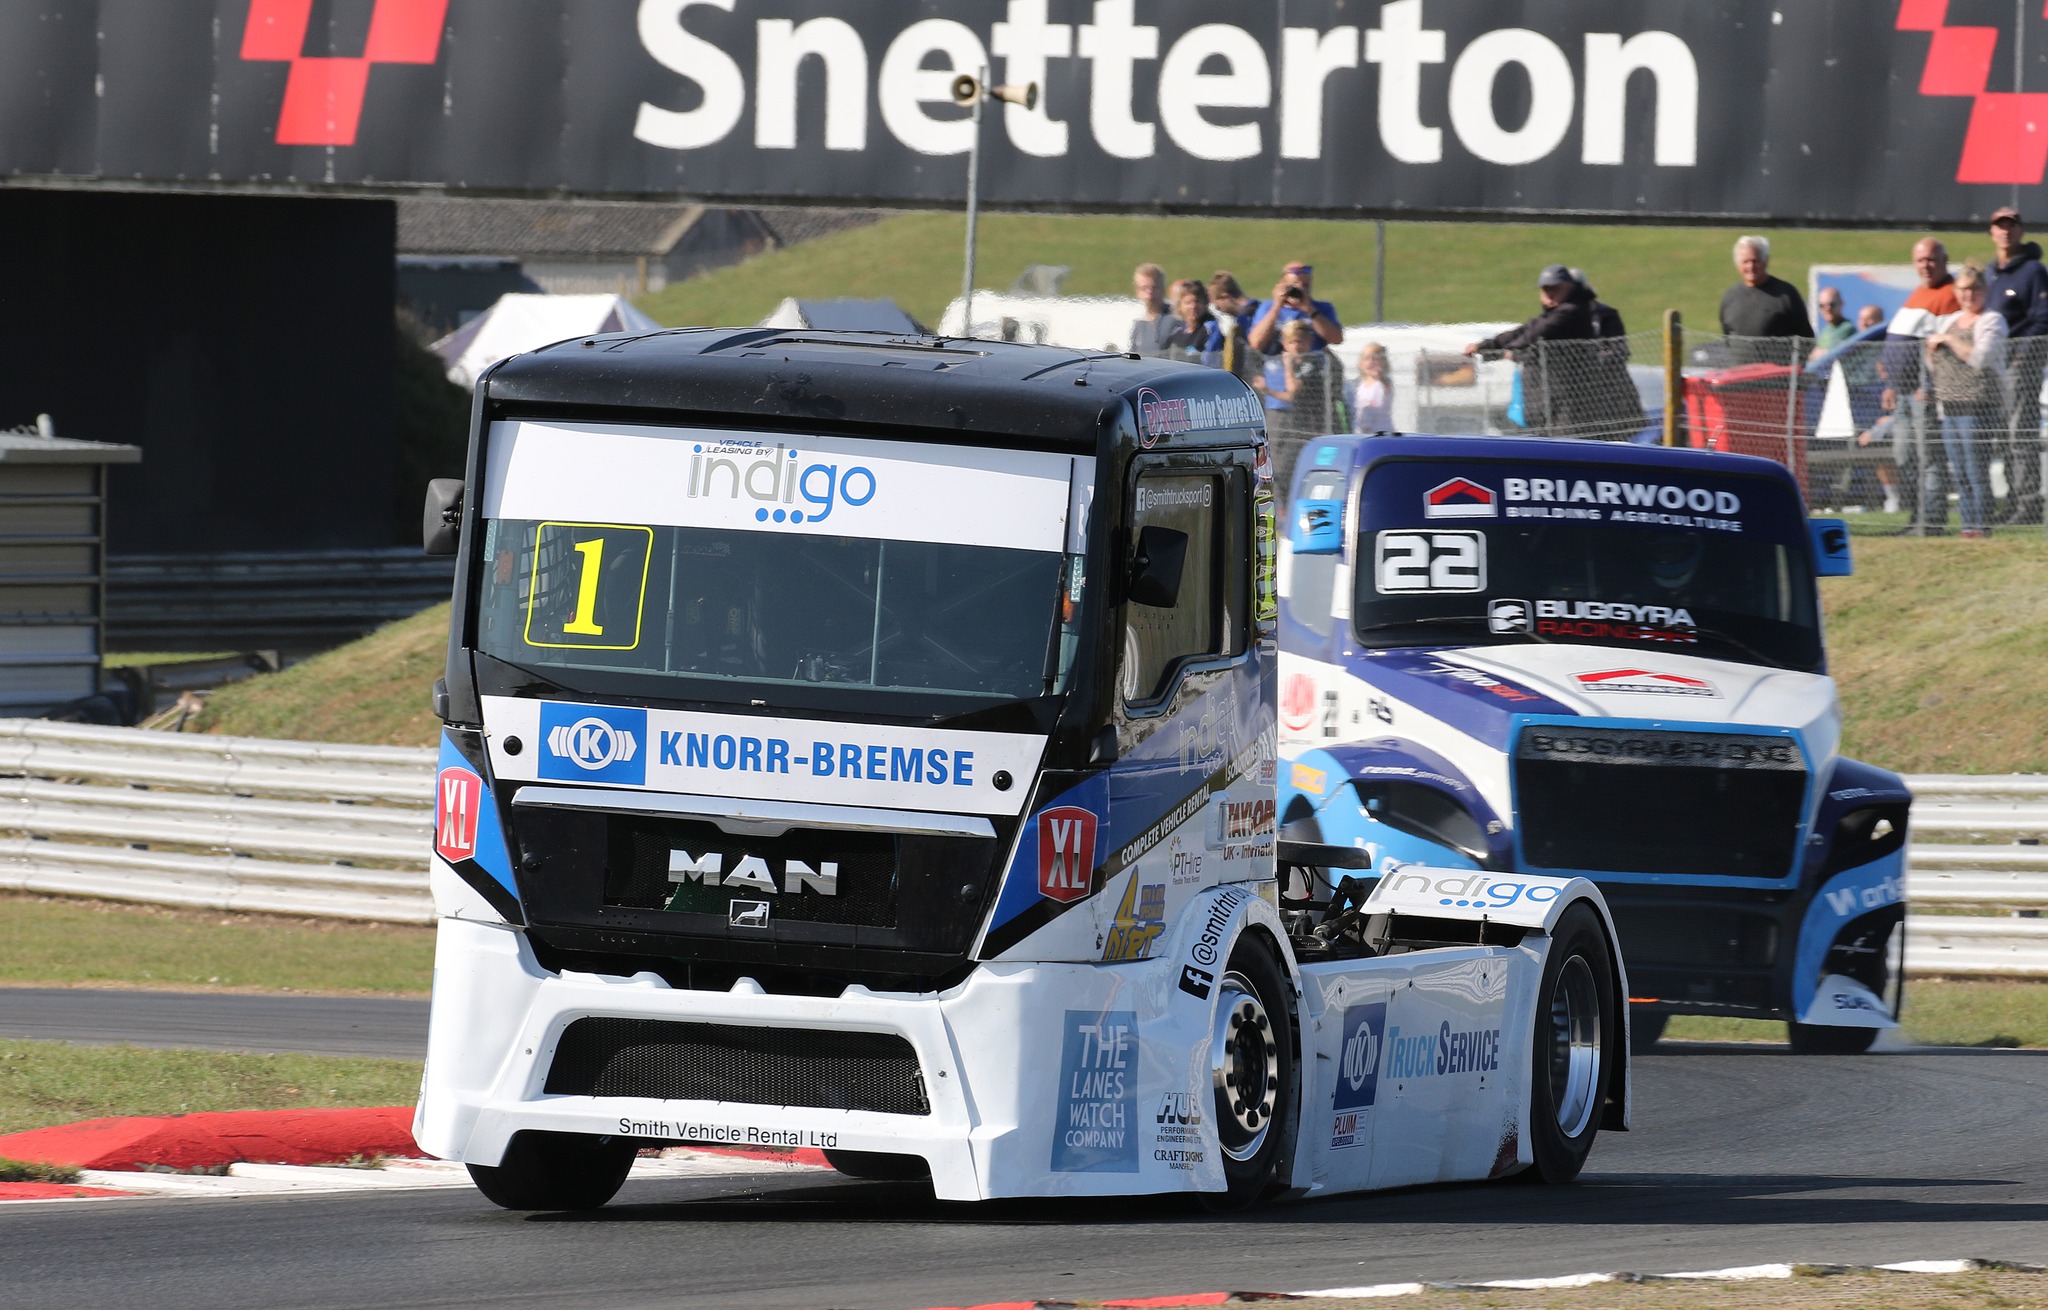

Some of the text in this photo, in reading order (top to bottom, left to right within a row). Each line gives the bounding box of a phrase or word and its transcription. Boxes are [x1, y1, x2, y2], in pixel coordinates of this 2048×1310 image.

[633, 0, 1699, 166] Snetterton
[1188, 397, 1217, 430] Motor
[1215, 394, 1248, 429] Spares
[706, 446, 771, 456] LEASING BY
[719, 438, 762, 449] VEHICLE
[688, 442, 877, 524] indigo
[1503, 477, 1742, 515] BRIARWOOD
[1505, 506, 1743, 532] BUILDING AGRICULTURE
[1383, 534, 1480, 589] 22
[562, 537, 605, 637] 1
[1536, 599, 1698, 627] BUGGYRA
[1537, 621, 1640, 641] RACING
[660, 730, 974, 788] KNORR-BREMSE
[441, 779, 470, 850] XL
[1121, 827, 1160, 866] COMPLETE
[1159, 805, 1187, 839] VEHICLE
[1186, 782, 1211, 821] RENTAL
[1046, 818, 1086, 889] XL
[1223, 846, 1236, 861] UK
[667, 848, 839, 897] MAN
[1379, 868, 1562, 908] indigo
[1078, 1025, 1128, 1069] THE
[1071, 1071, 1125, 1099] LANES
[1070, 1102, 1125, 1129] WATCH
[1156, 1092, 1202, 1125] HUB
[619, 1117, 838, 1148] Smith Vehicle Rental Ltd
[1065, 1130, 1126, 1149] COMPANY
